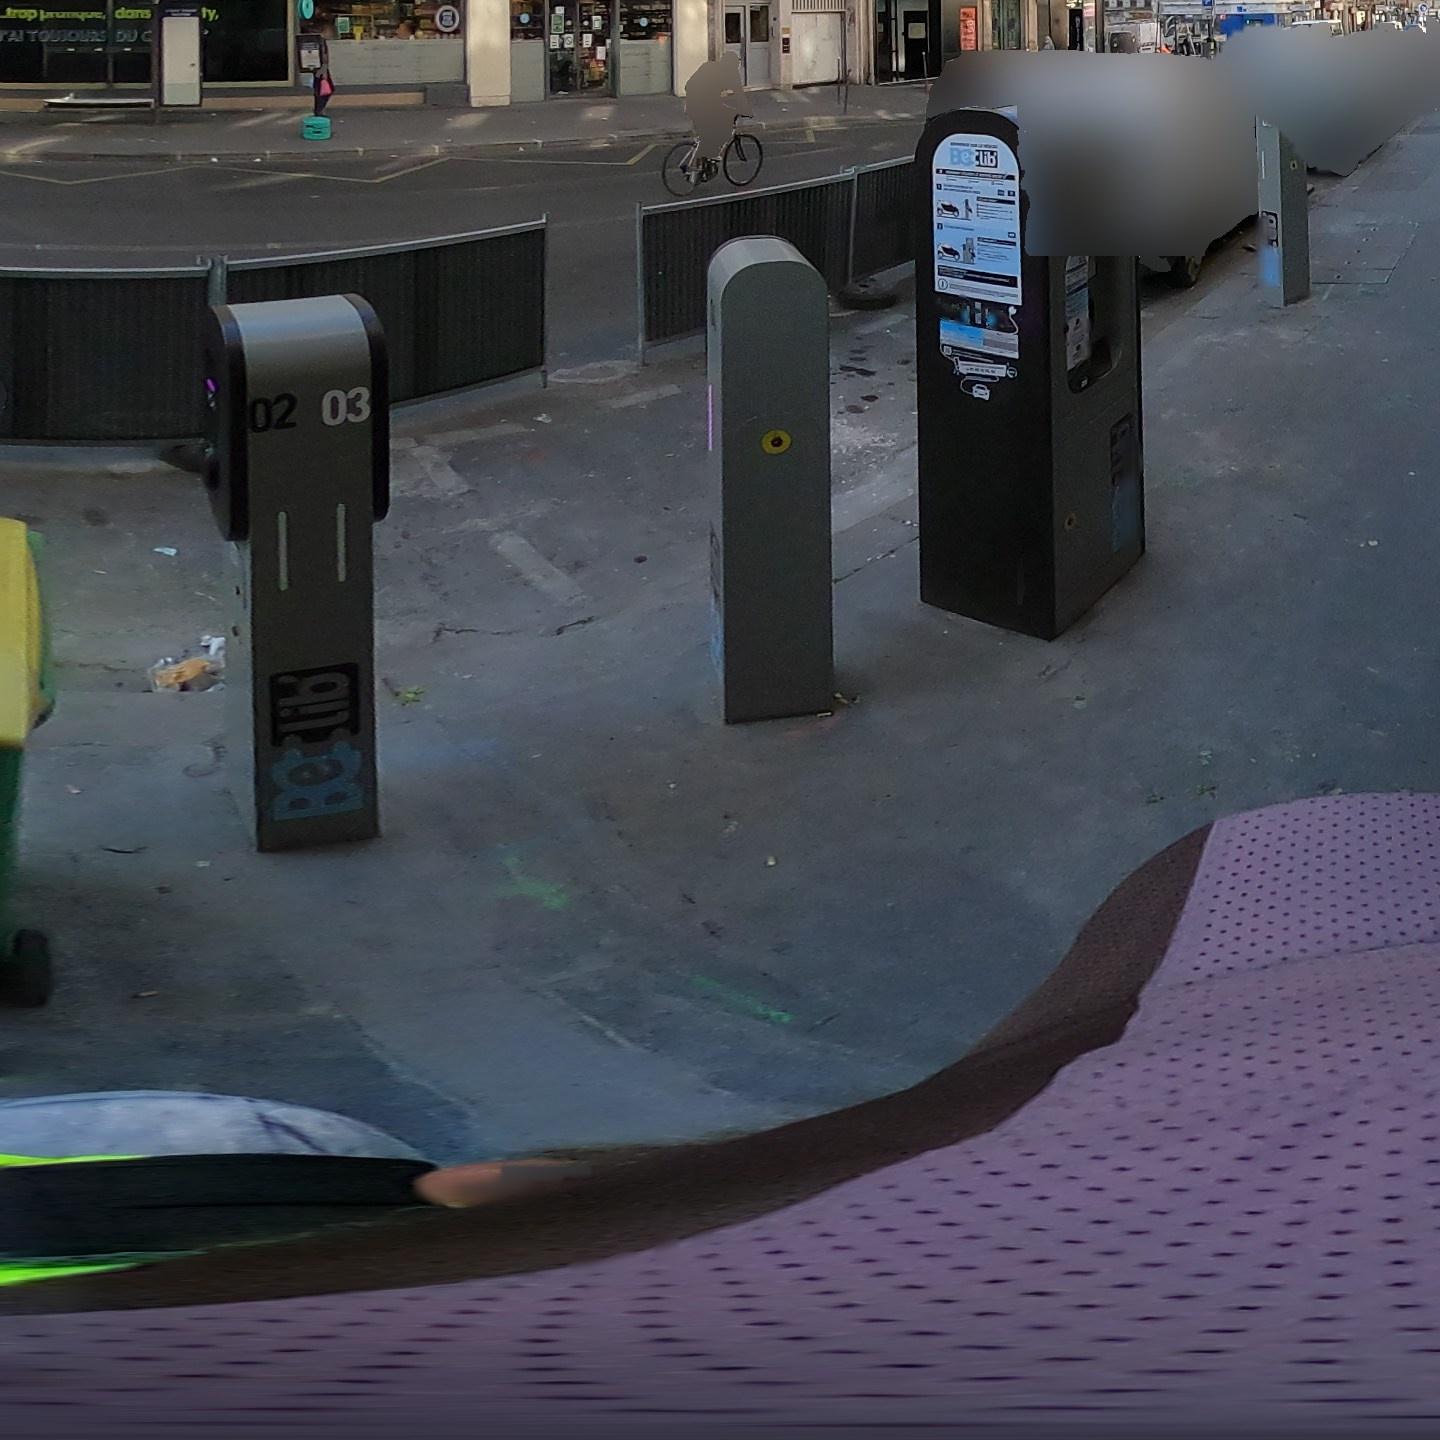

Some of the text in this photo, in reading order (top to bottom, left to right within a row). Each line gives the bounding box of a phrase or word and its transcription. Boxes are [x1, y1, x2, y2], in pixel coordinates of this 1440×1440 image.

[114, 6, 151, 20] dans
[253, 386, 371, 434] 02 03
